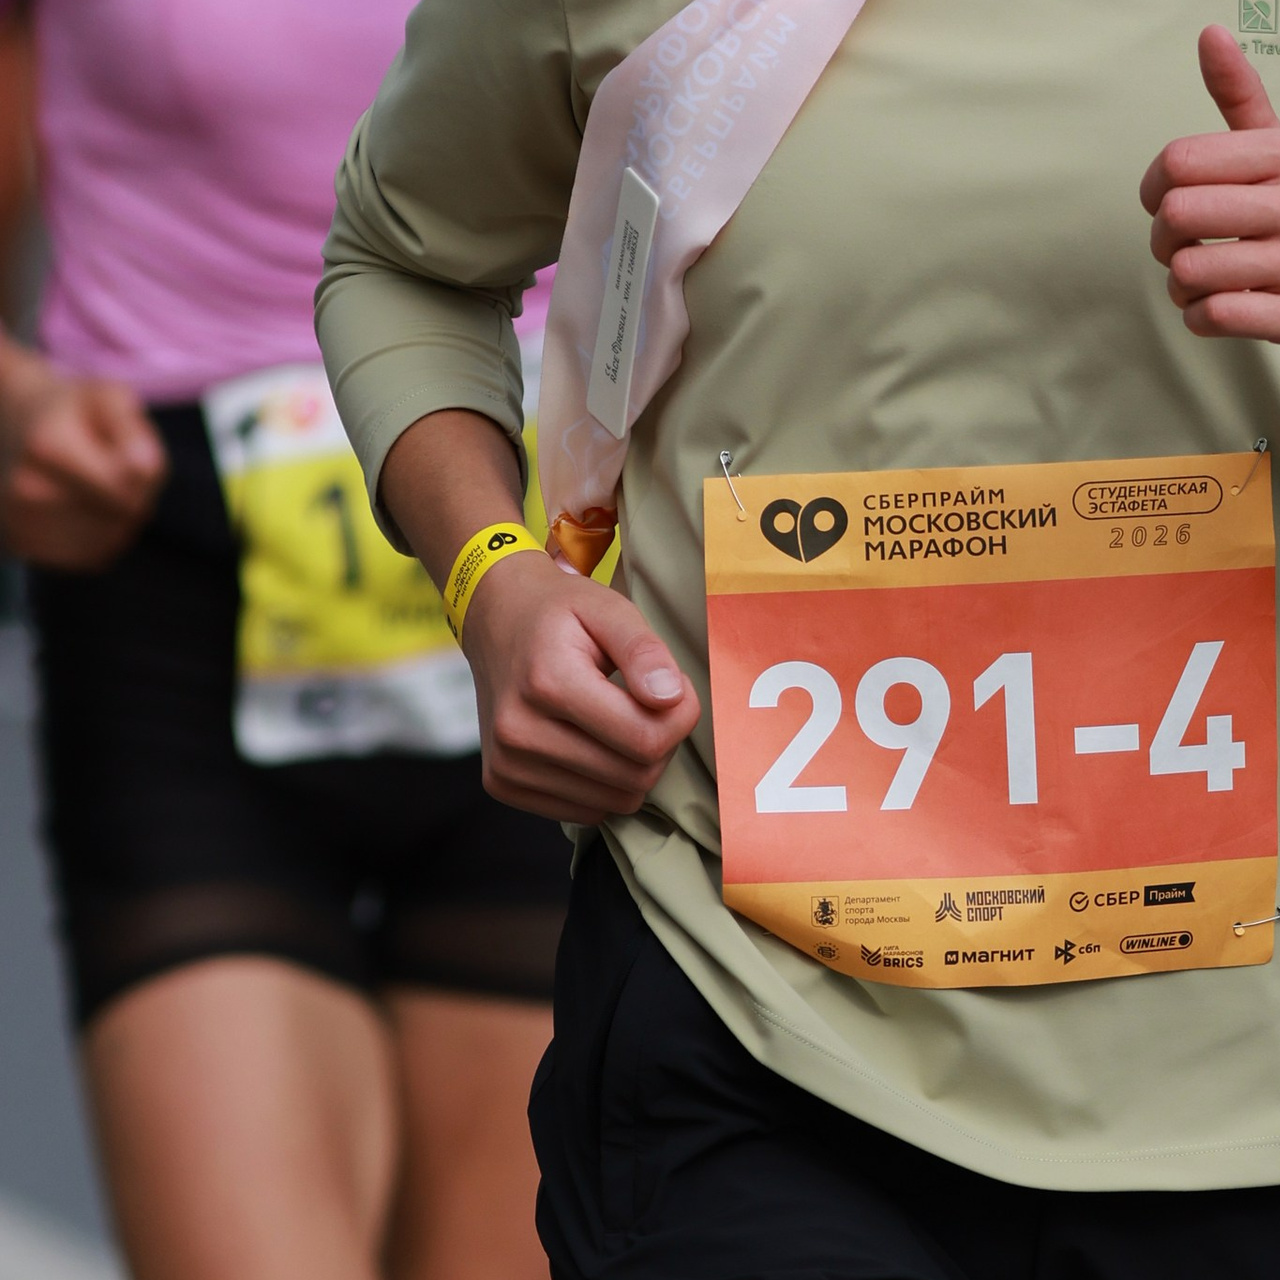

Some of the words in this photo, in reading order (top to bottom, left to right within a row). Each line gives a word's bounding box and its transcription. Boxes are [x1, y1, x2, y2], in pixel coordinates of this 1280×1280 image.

[609, 354, 620, 384] RACE
[616, 306, 628, 346] RESULT
[863, 486, 1005, 510] СБЕРПРАЙМ
[1087, 481, 1208, 501] СТУДЕНЧЕСКАЯ
[1088, 498, 1168, 515] ЭСТАФЕТА
[863, 503, 1057, 536] МОСКОВСКИЙ
[1109, 523, 1191, 549] 2026
[864, 535, 1007, 561] МАРАФОН
[748, 640, 1247, 814] 291-4
[844, 895, 901, 906] Департамент
[965, 885, 1045, 907] МОСКОВСКИЙ
[1094, 890, 1141, 907] СБЕР
[1149, 888, 1186, 902] Прайм
[844, 907, 875, 916] спорта
[845, 917, 875, 926] города
[876, 915, 911, 924] Москвы
[966, 906, 1004, 922] СПОРТ
[1078, 943, 1101, 954] сбп
[1125, 936, 1177, 950] WINLINE
[883, 957, 924, 968] BRICS
